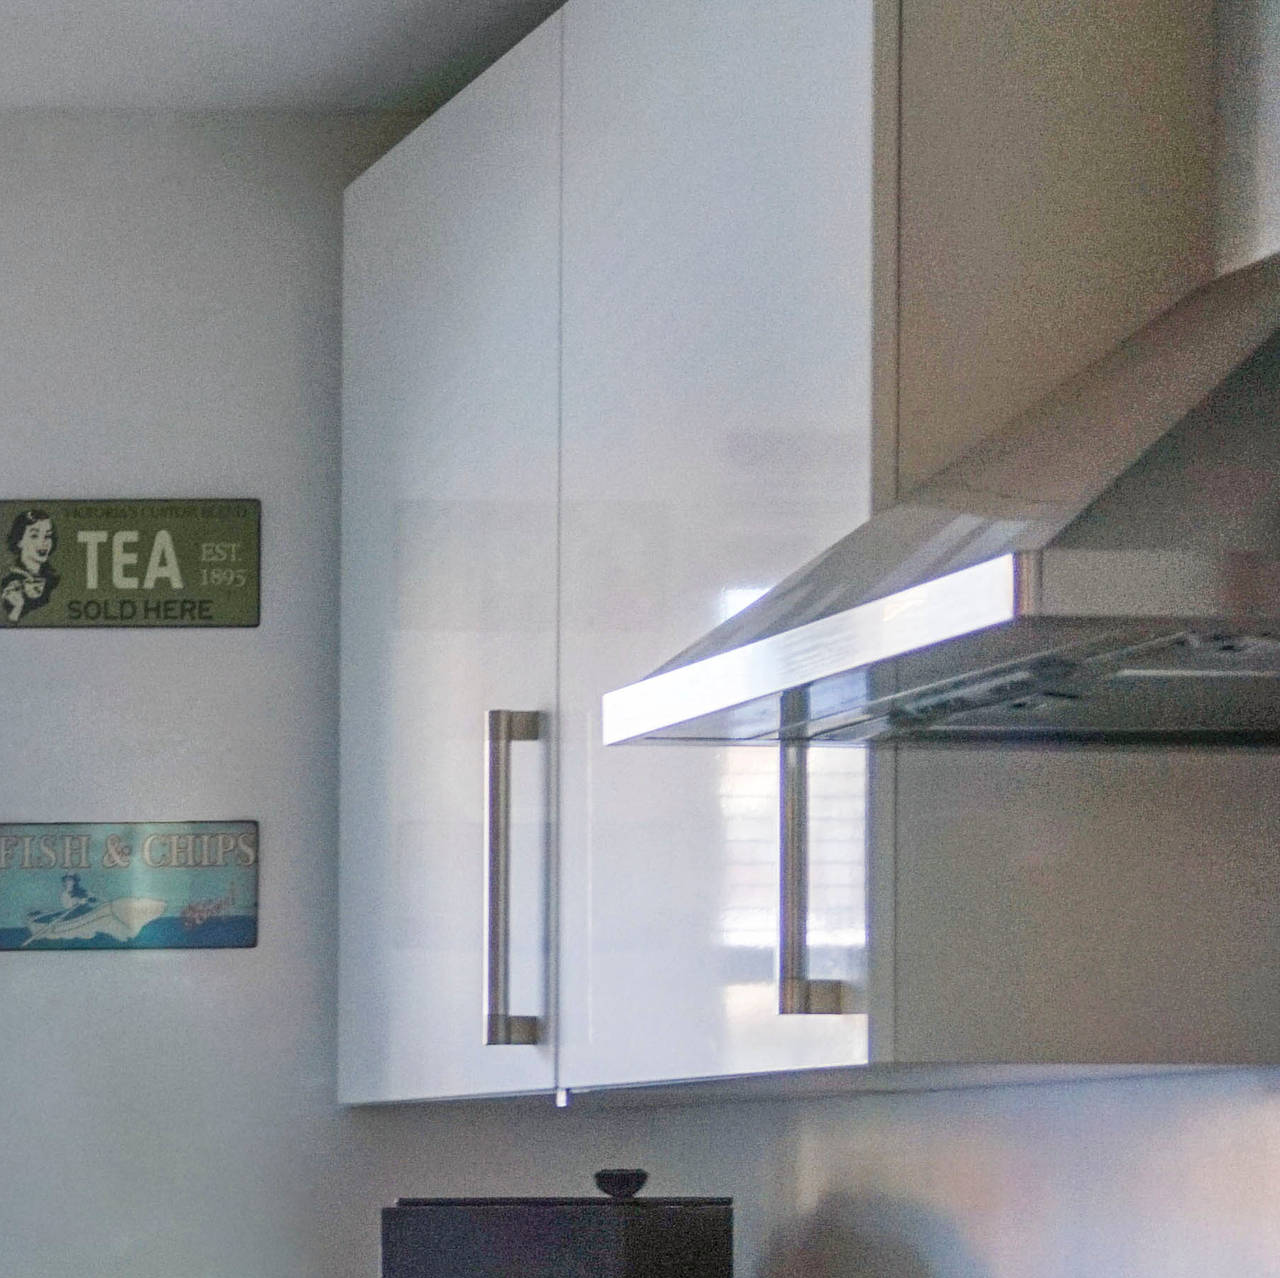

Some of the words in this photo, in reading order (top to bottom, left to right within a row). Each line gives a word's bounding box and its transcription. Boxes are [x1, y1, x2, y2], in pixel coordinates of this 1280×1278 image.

[77, 530, 184, 589] TEA
[67, 600, 137, 620] SOLD
[143, 600, 214, 620] HERE
[102, 833, 131, 869] &
[142, 831, 258, 868] CHIPS
